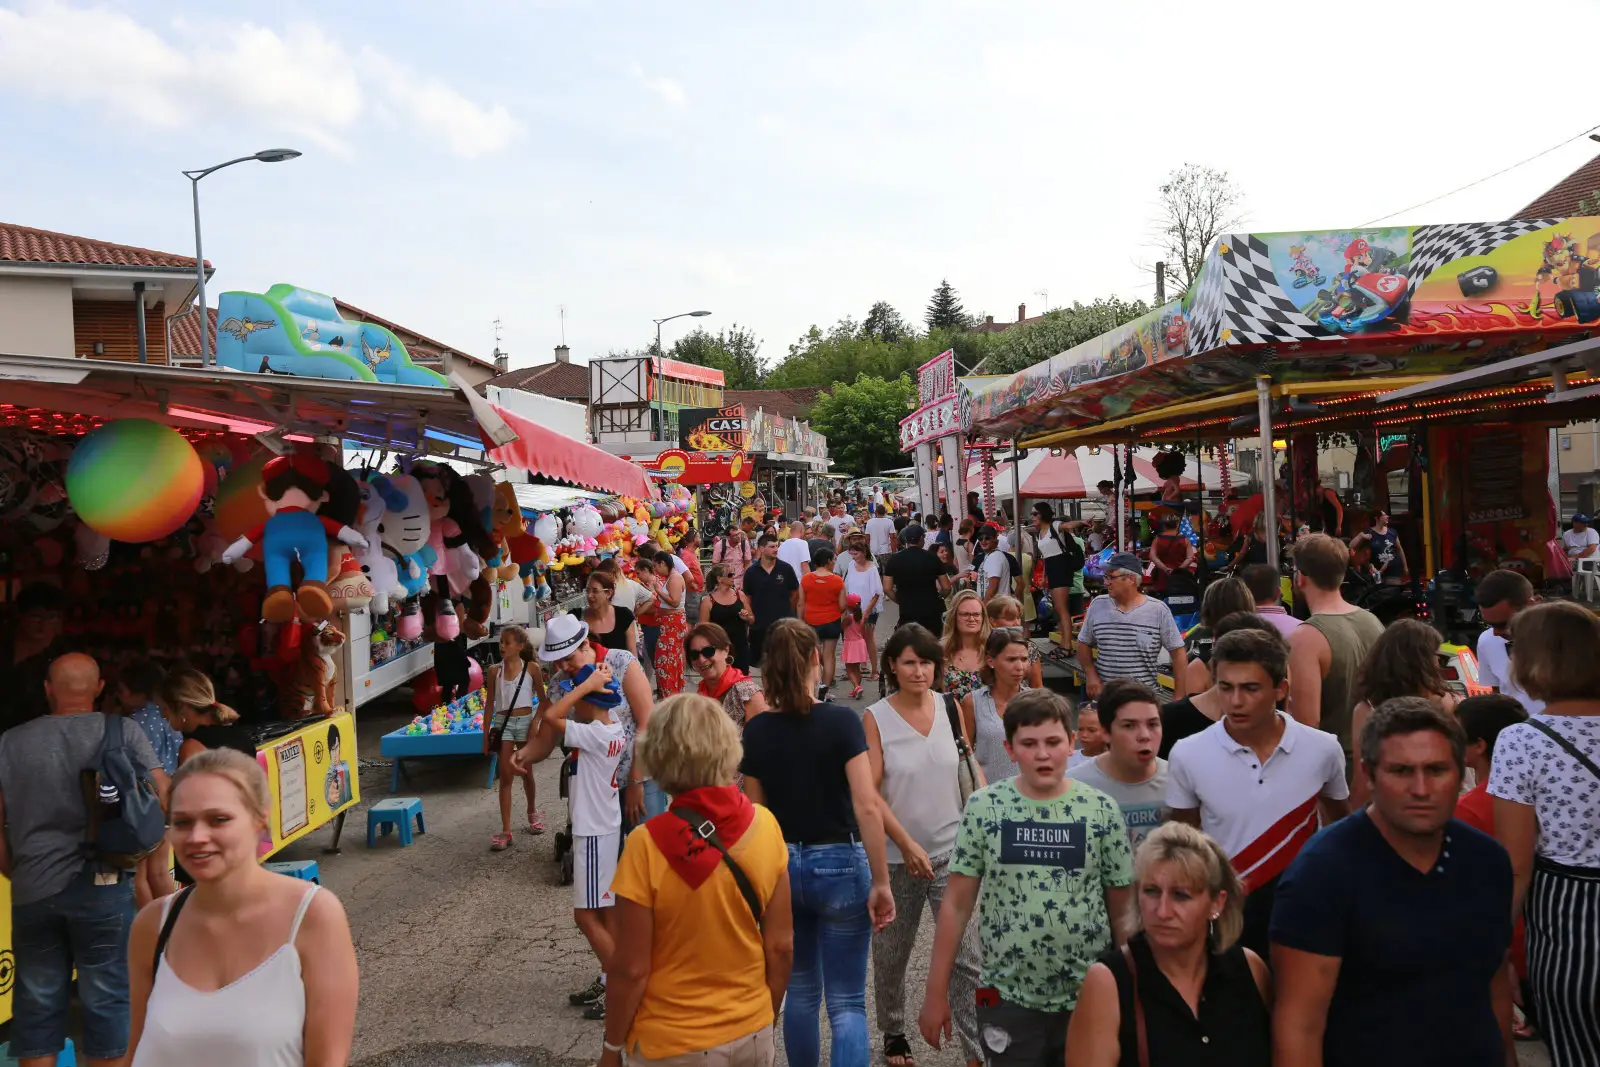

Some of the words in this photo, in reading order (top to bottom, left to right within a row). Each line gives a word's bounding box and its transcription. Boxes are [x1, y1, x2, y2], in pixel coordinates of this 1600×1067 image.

[280, 744, 300, 761] WANTED
[1123, 809, 1158, 826] YORK
[1023, 849, 1062, 860] SUNSET
